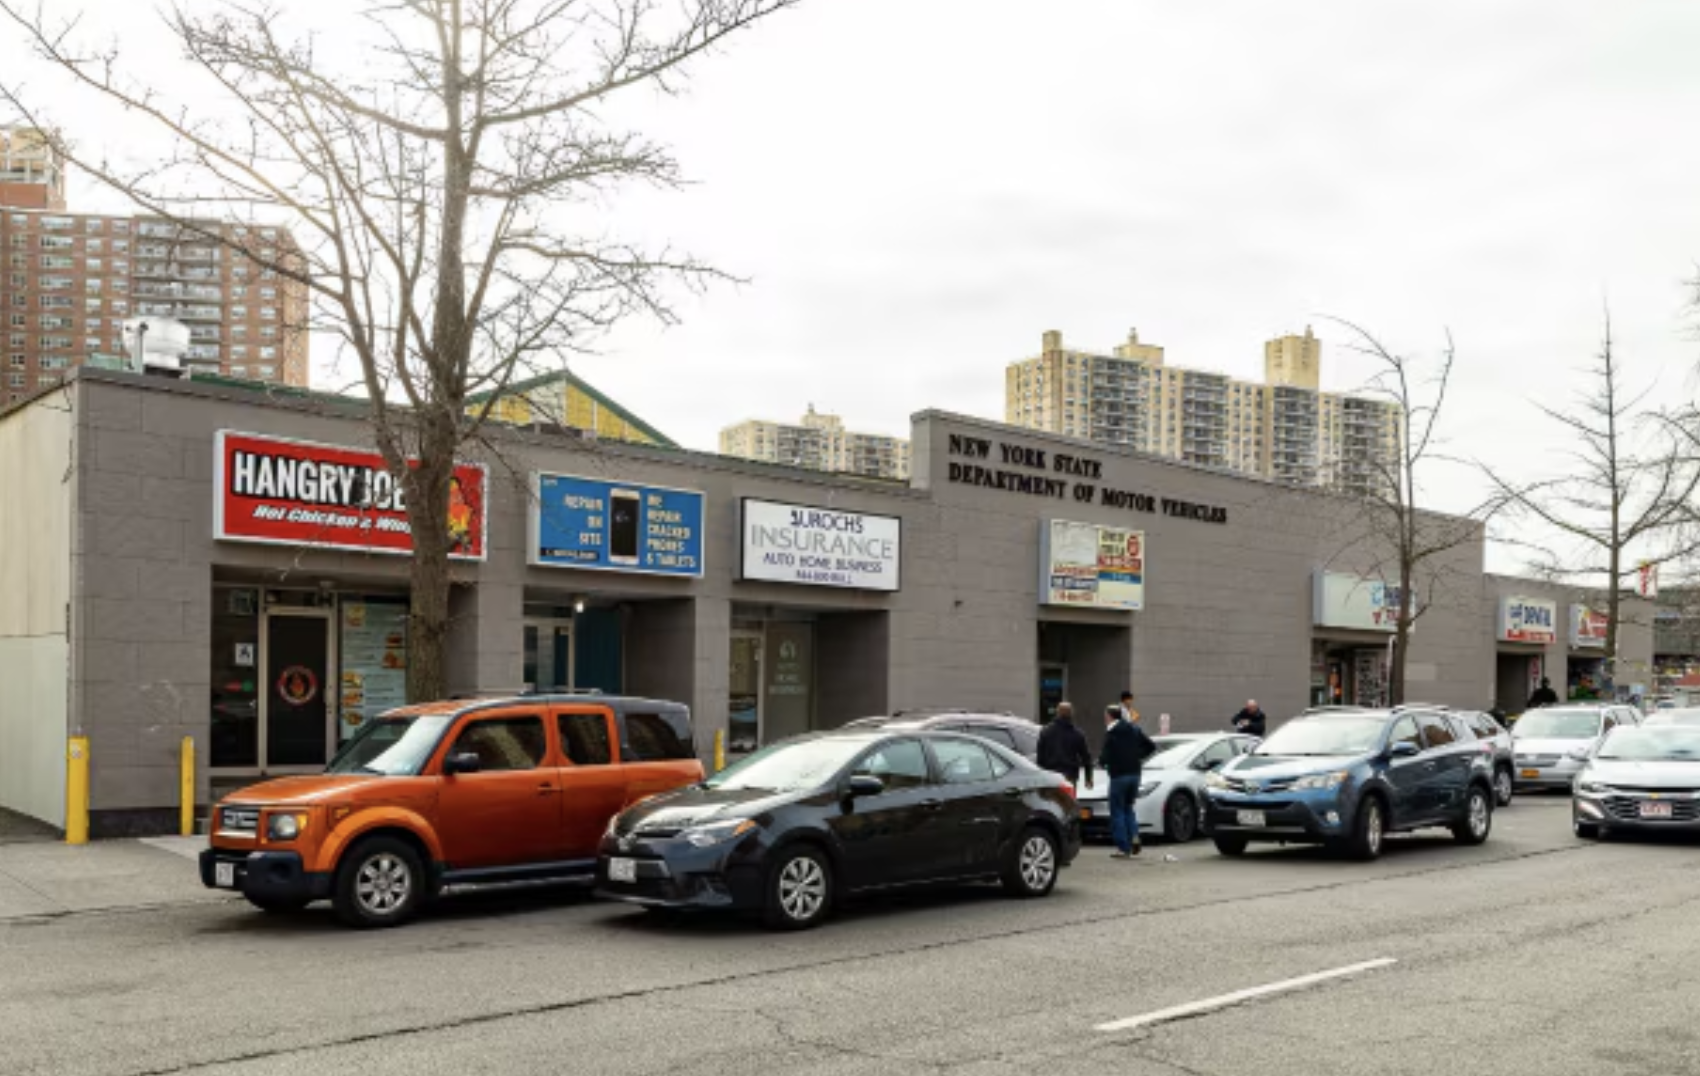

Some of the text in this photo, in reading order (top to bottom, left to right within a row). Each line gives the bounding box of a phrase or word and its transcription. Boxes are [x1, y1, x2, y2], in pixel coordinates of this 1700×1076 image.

[949, 434, 1102, 478] NEW YORK STATE
[233, 450, 407, 512] HANGRY JOE
[949, 463, 1227, 524] DEPARTMENT OF MOTOR VEHICLES
[253, 504, 285, 521] Hot
[287, 507, 358, 528] Chicken
[563, 493, 603, 511] REPAIR
[647, 509, 681, 522] REPAIR
[752, 524, 893, 560] INSURANCE
[763, 553, 883, 573] AUTO HOME BUSINESS
